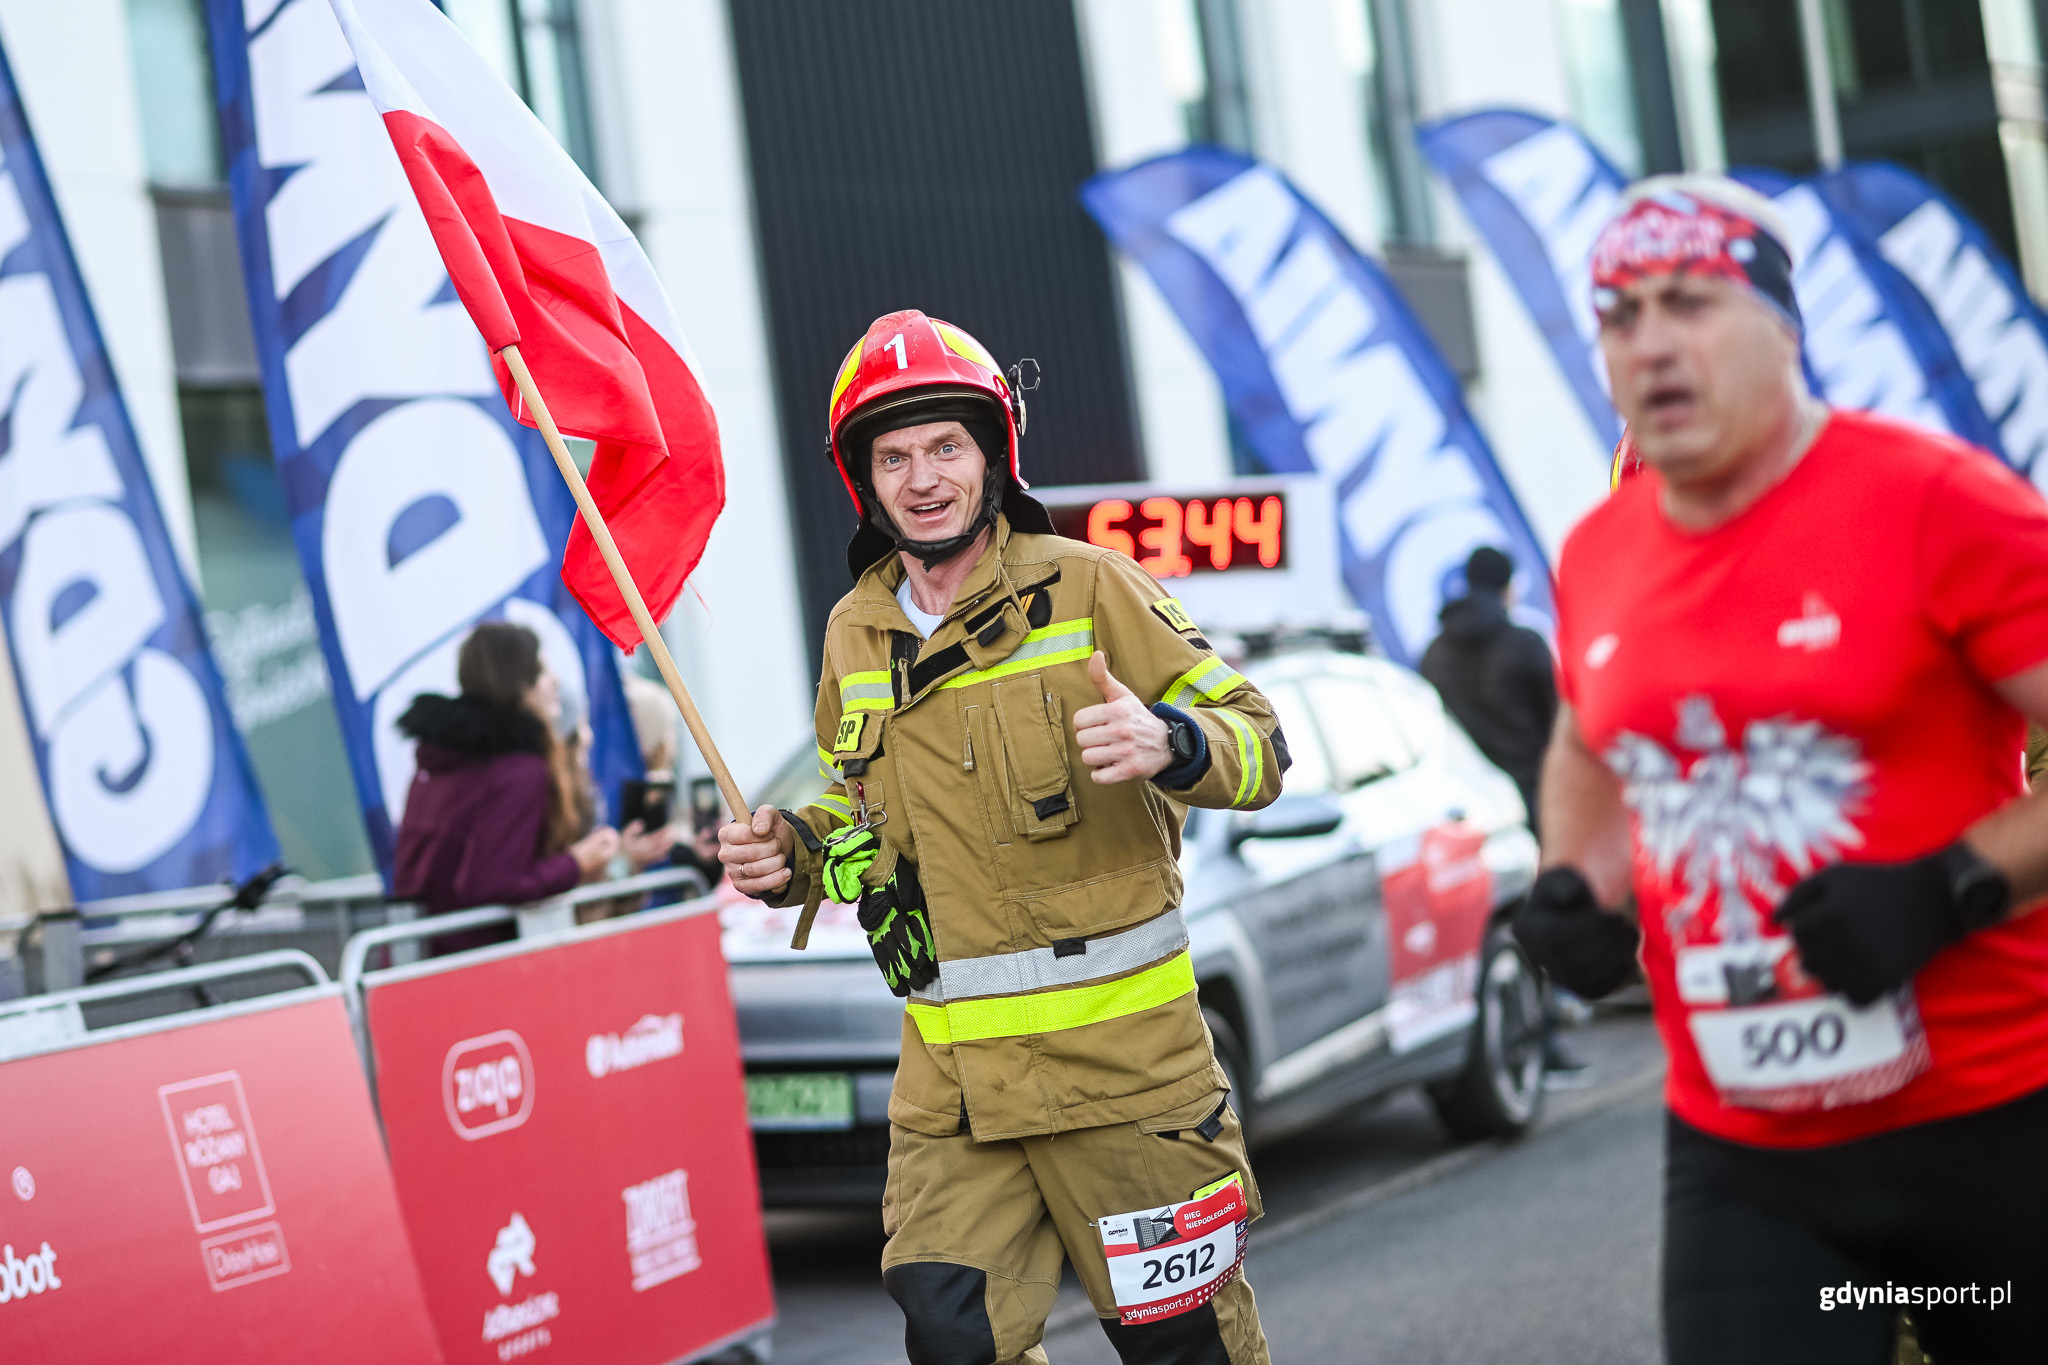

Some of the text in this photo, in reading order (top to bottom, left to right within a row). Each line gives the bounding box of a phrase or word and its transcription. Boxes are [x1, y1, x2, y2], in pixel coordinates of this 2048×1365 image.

[884, 333, 908, 370] 1
[1741, 1010, 1846, 1072] 500
[1183, 1210, 1201, 1221] BIEG
[1185, 1201, 1237, 1230] NIEPODLEGŁOŚCI
[1142, 1242, 1216, 1291] 2612
[1125, 1293, 1194, 1321] gdyniasport.pl
